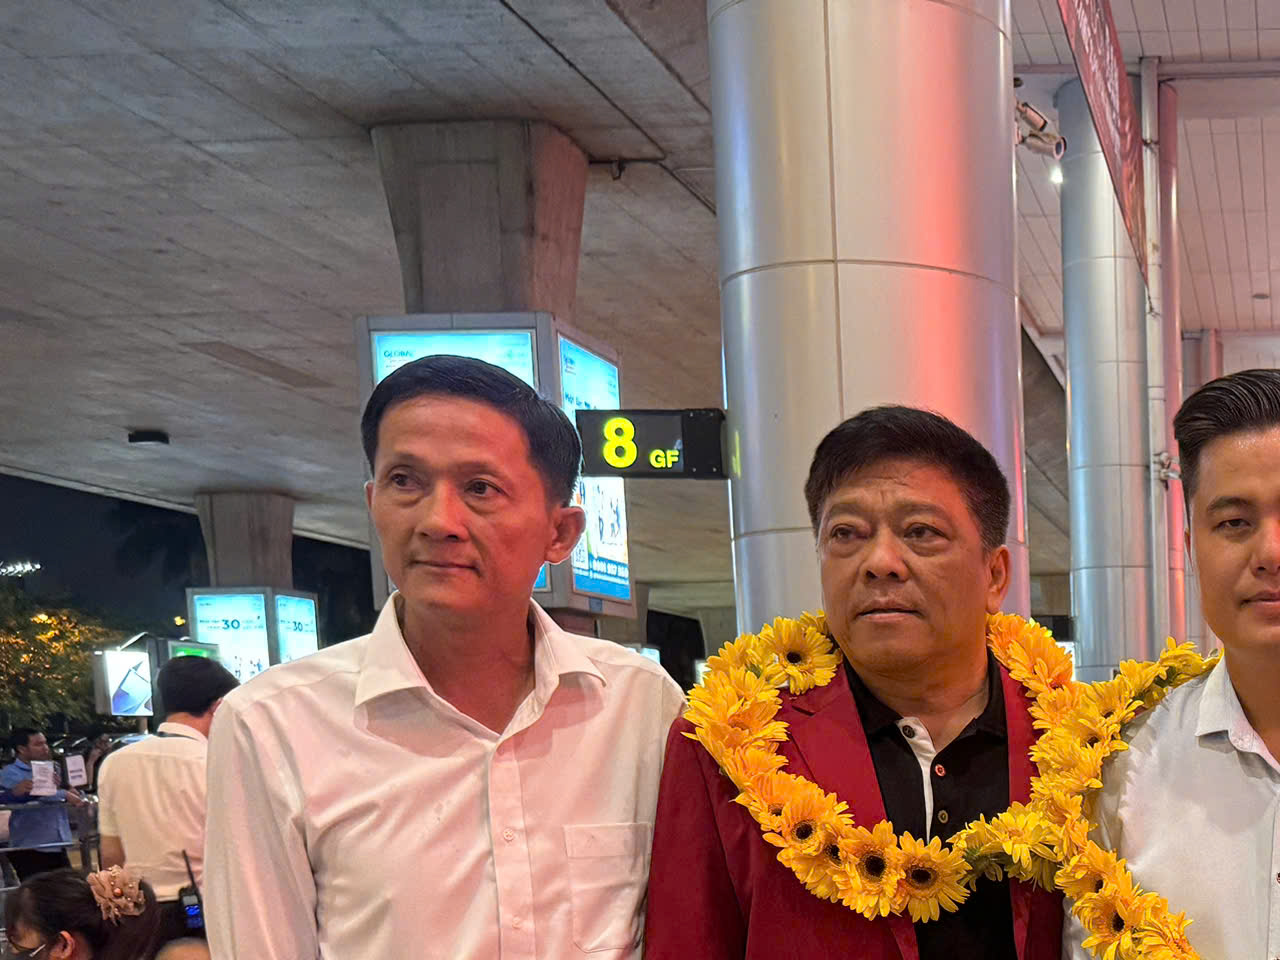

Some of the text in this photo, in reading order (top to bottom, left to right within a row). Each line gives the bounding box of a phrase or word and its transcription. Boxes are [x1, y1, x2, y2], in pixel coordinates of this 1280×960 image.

[603, 417, 680, 468] 8 GF
[221, 619, 240, 630] 30
